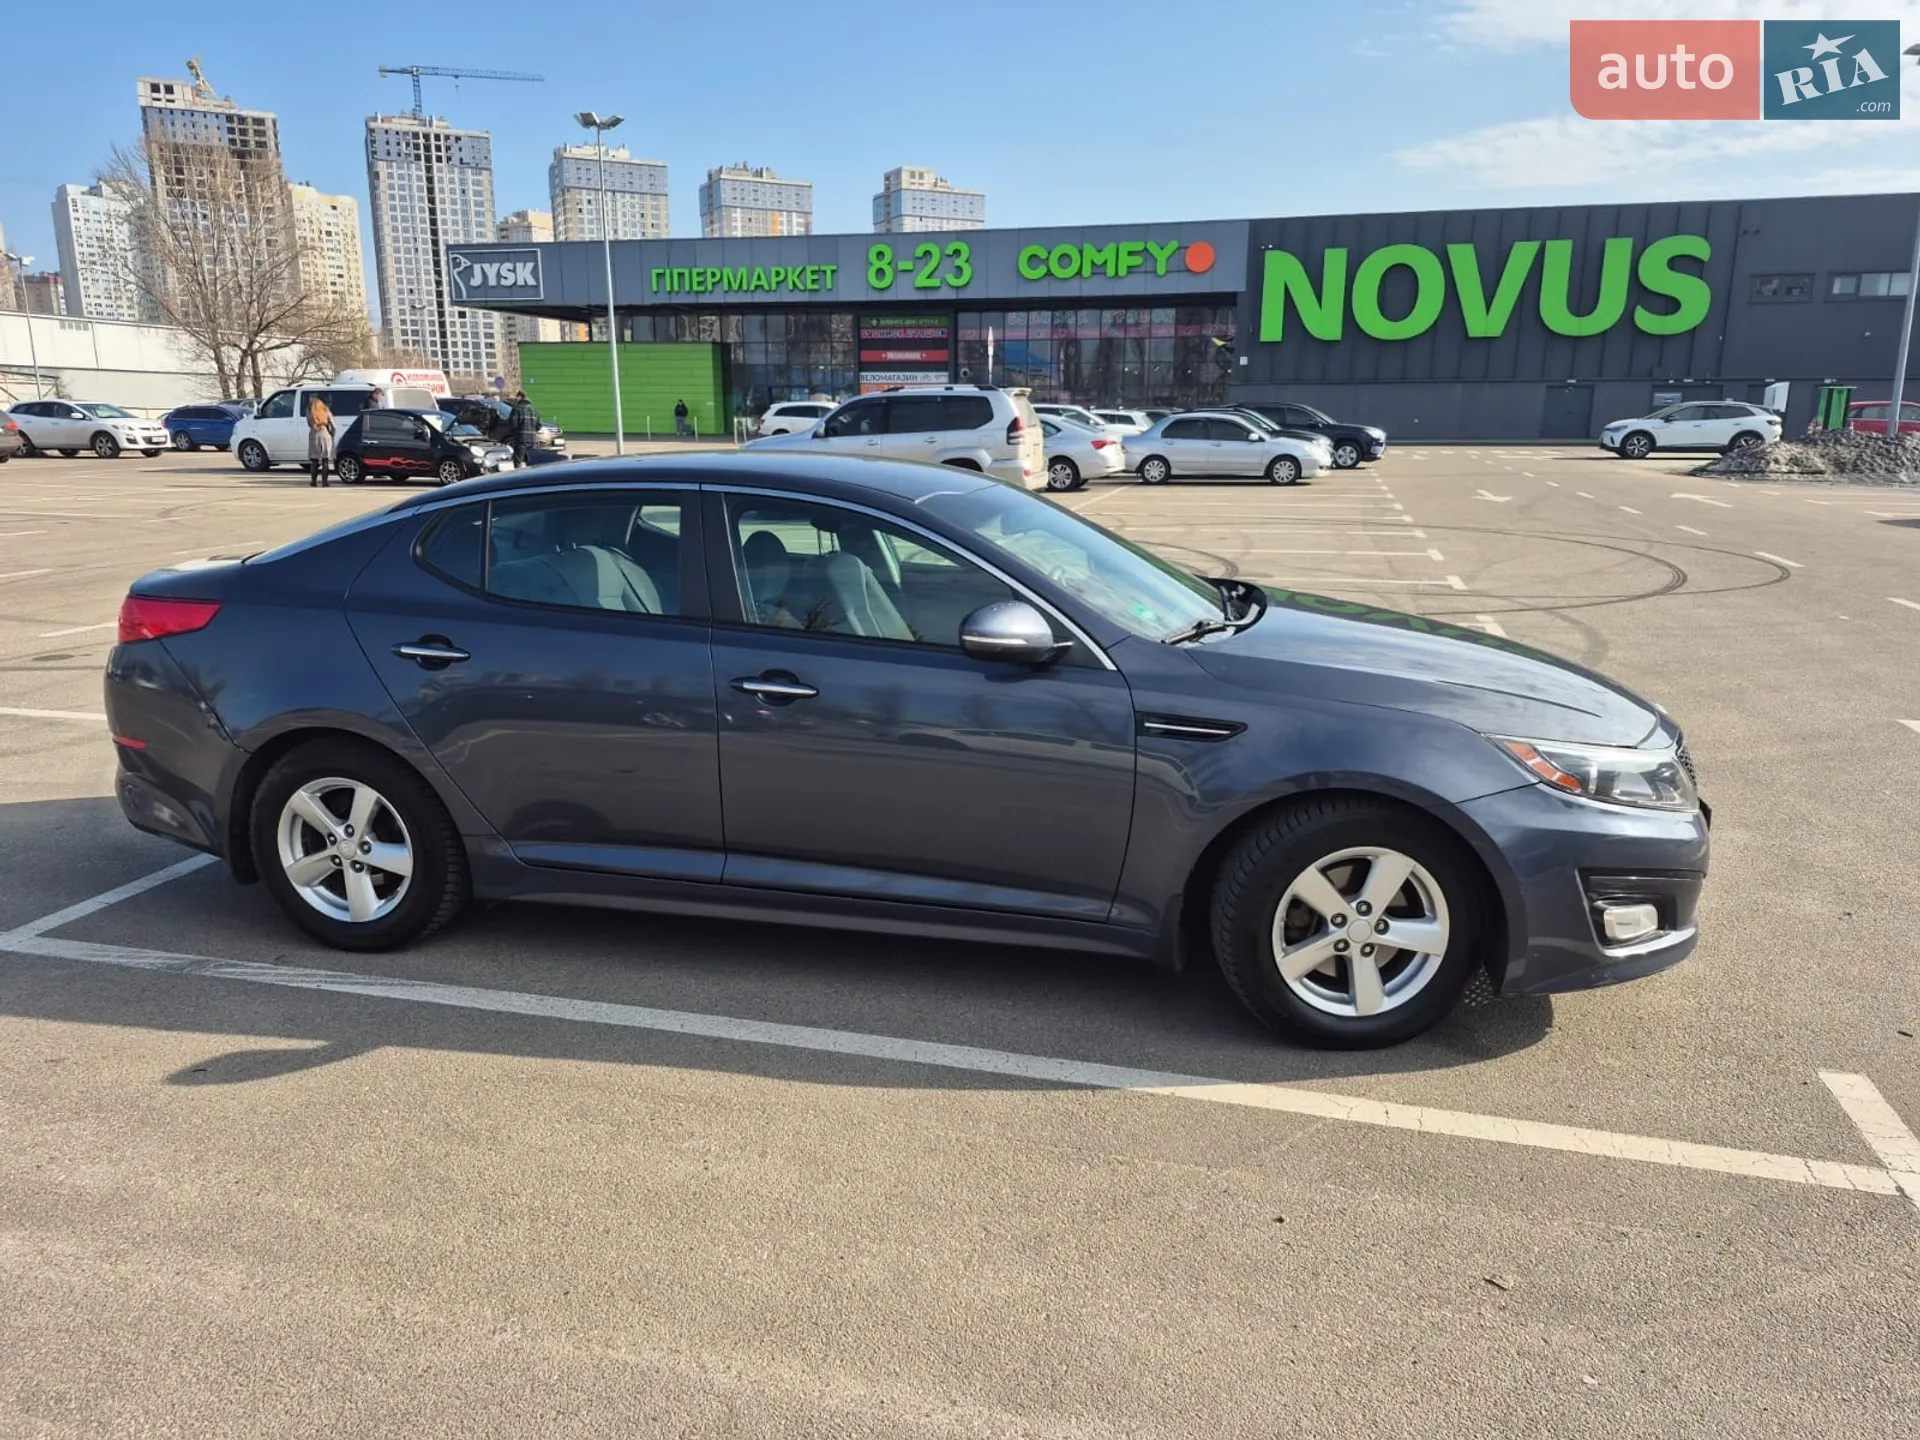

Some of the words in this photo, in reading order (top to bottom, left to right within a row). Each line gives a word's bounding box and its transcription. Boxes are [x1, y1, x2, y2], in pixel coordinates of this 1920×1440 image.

[470, 262, 538, 287] JYSK
[651, 265, 838, 294] ГІПЕРМАРКЕТ
[867, 241, 974, 290] 8-23
[1017, 240, 1180, 280] COMFY
[1259, 234, 1712, 343] NOVUS
